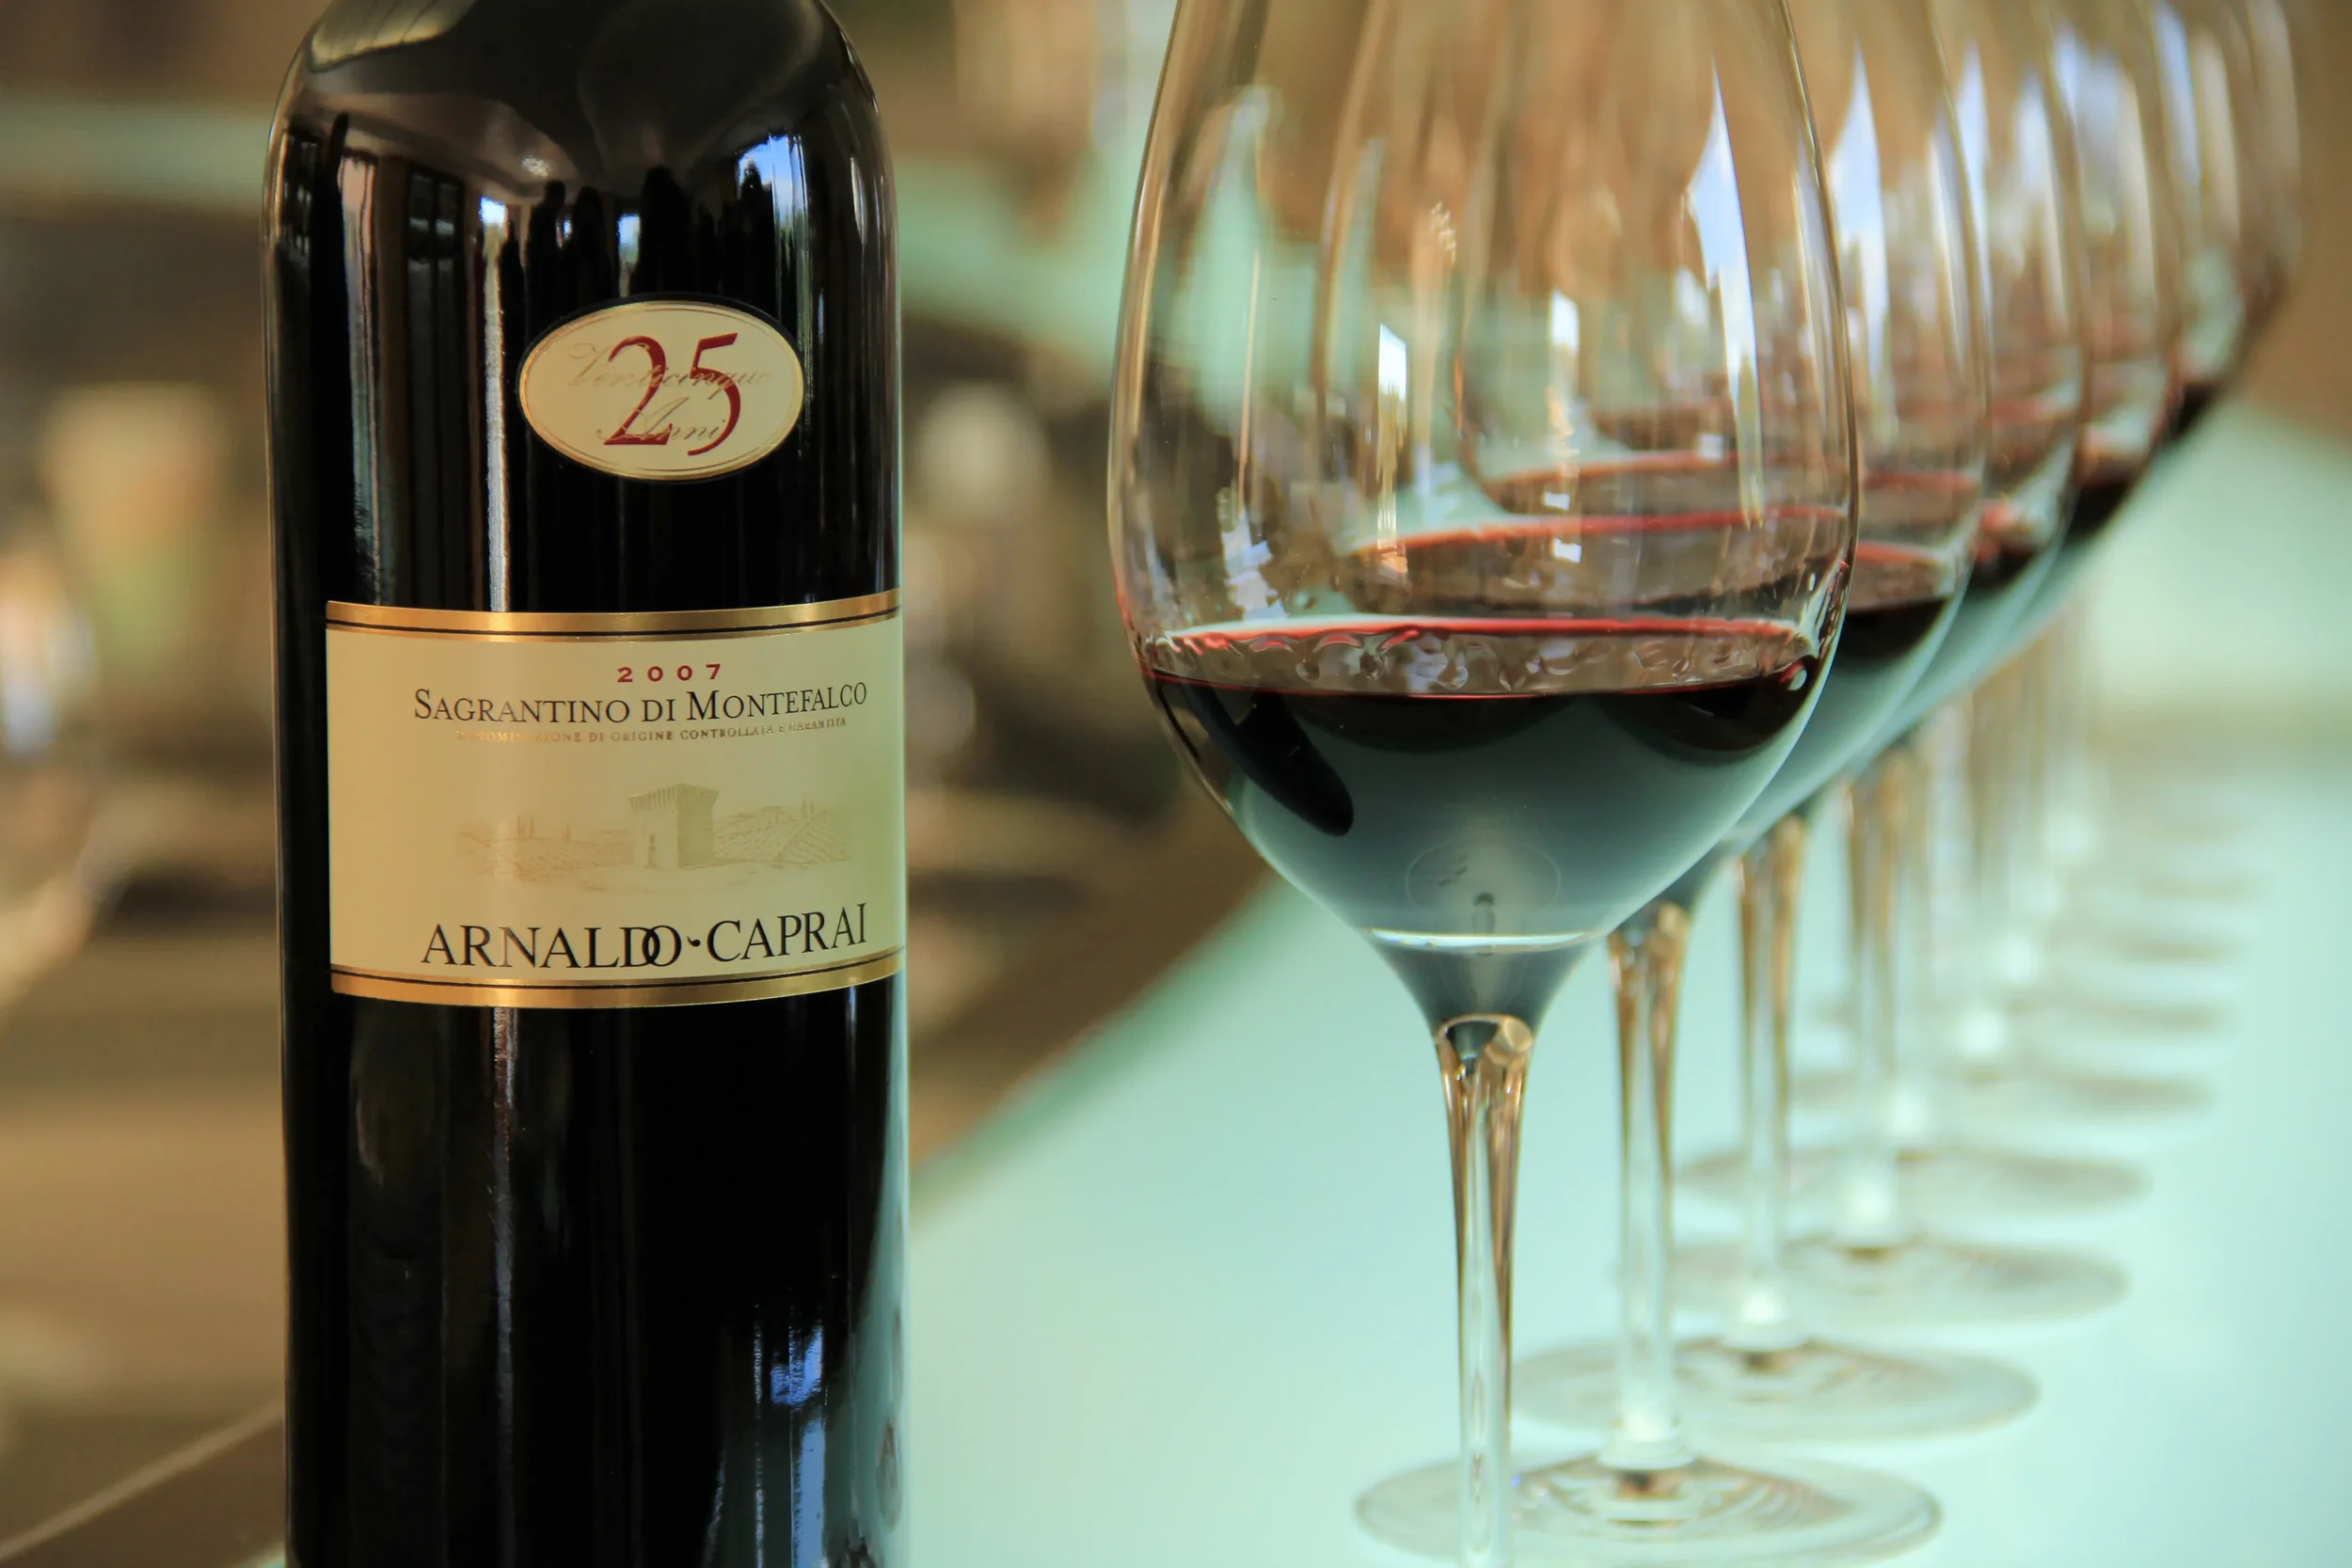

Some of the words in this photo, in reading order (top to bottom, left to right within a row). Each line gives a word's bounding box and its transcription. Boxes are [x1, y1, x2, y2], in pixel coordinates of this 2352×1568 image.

[604, 332, 741, 456] 25
[617, 663, 721, 683] 2007
[414, 689, 630, 722] SAGRANTINO
[642, 698, 676, 721] DI
[686, 682, 867, 721] MONTEFALCO
[588, 732, 605, 742] DI
[611, 731, 674, 742] ORIGINE
